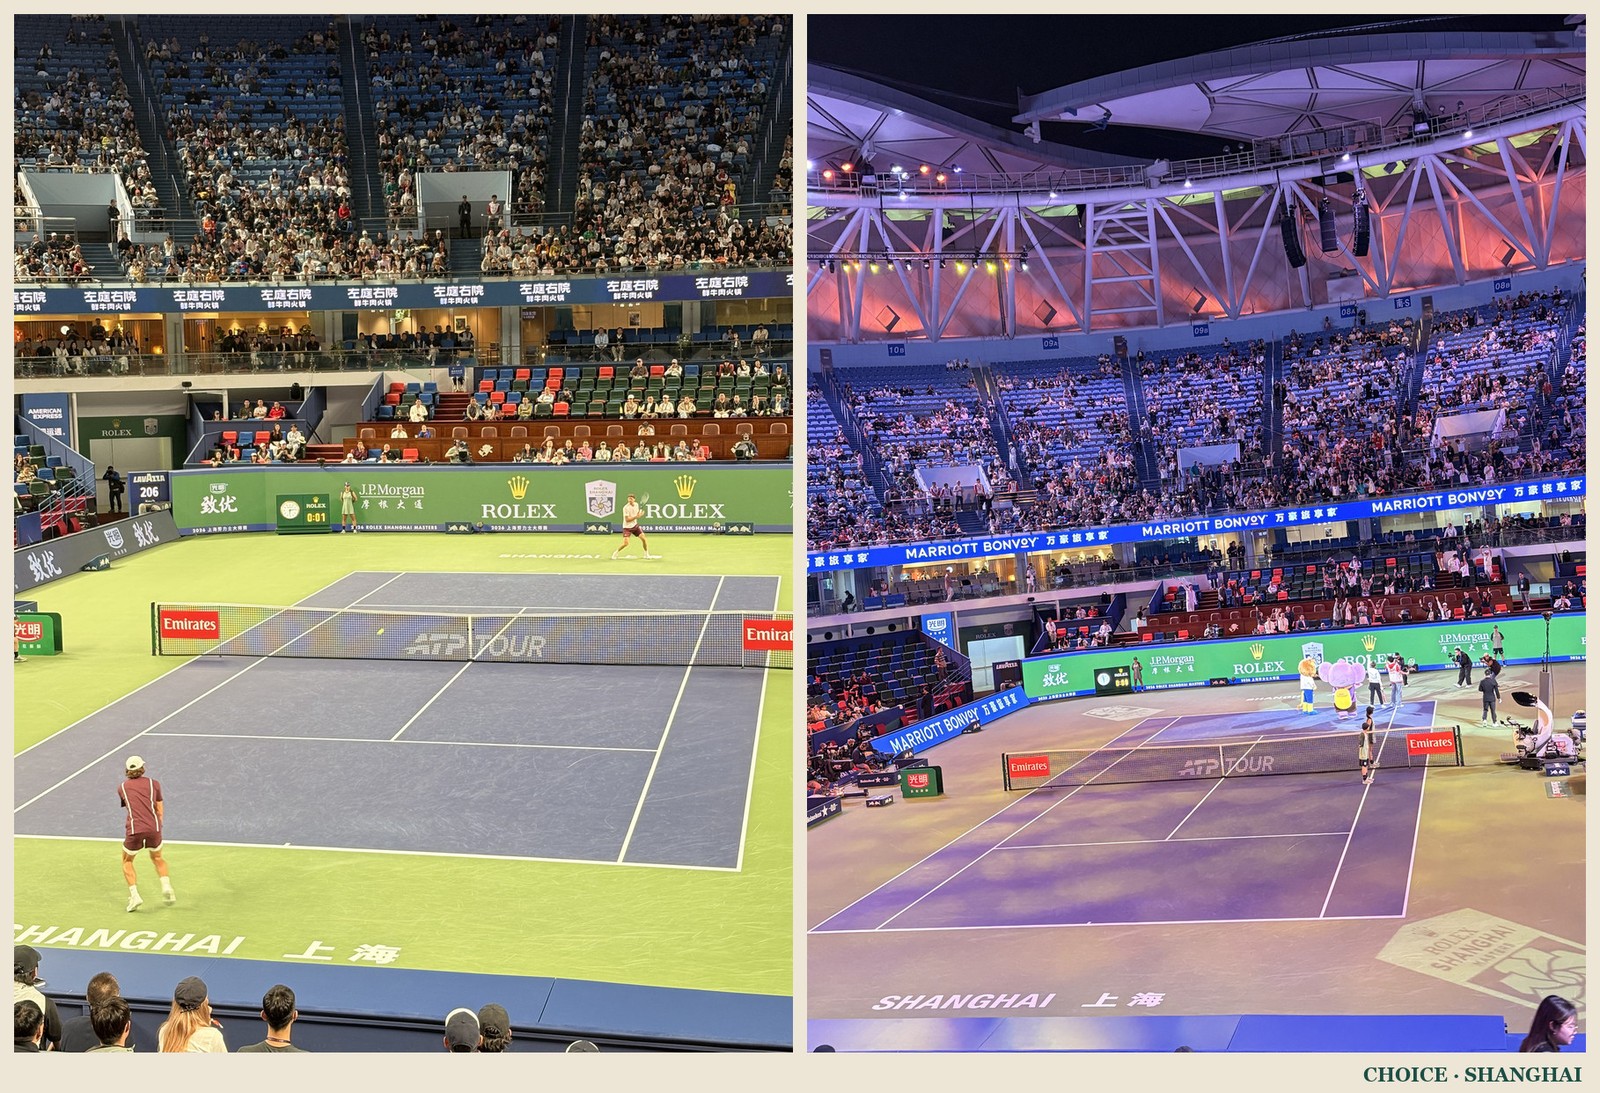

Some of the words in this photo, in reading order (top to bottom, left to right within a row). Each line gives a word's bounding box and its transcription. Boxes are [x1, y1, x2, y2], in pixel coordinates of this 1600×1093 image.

[520, 282, 571, 296] 左庭右院
[607, 280, 658, 292] 左庭右院
[695, 276, 748, 289] 左庭右院
[84, 290, 137, 303] 左庭右院
[173, 290, 225, 302] 左庭右院
[260, 289, 312, 300] 左庭右院
[348, 288, 398, 299] 左庭右院
[433, 285, 484, 298] 左庭右院
[1043, 339, 1059, 348] 09A
[102, 429, 132, 437] ROLEX
[133, 474, 166, 483] LAVAZZA
[140, 486, 159, 498] 206
[359, 484, 424, 498] J.P.Morgan
[1372, 496, 1443, 513] MARRIOTT
[1448, 488, 1506, 506] BONVOY
[1514, 480, 1582, 497] 万豪旅享家
[200, 494, 238, 514] 致优
[361, 499, 424, 510] 摩根大通
[481, 504, 558, 518] ROLEX
[646, 504, 726, 518] ROLEX
[306, 512, 326, 522] 0:01
[1142, 520, 1210, 537] MARRIOTT
[1215, 514, 1268, 530] BONVOY
[1276, 507, 1338, 522] 万豪旅享家
[132, 520, 160, 548] 致优
[906, 542, 978, 560] MARRIOTT
[984, 537, 1038, 552] BONVOY
[1046, 530, 1109, 546] 万豪旅享家
[27, 550, 62, 582] 致优
[807, 552, 869, 568] 豪旅享家
[14, 624, 40, 636] 光明
[164, 618, 216, 630] Emirates
[1438, 632, 1490, 644] J.P.Morgan
[404, 634, 466, 656] ATP
[475, 634, 546, 658] TOUR
[1150, 656, 1194, 666] J.P.Morgan
[1233, 661, 1286, 675] ROLEX
[1042, 672, 1068, 687] 致优
[890, 722, 944, 754] MARRIOTT
[942, 708, 978, 732] BONVOY
[1410, 737, 1452, 749] Emirates
[1011, 760, 1048, 772] Emirates
[1178, 758, 1219, 776] ATP
[1225, 755, 1274, 772] TOUR
[910, 774, 928, 784] 光明
[1424, 926, 1478, 956] ROLEX
[284, 940, 402, 964] 上海
[1430, 925, 1516, 972] SHANGHAI
[1473, 942, 1516, 967] MASTERS
[872, 994, 1056, 1010] SHANGHAI
[1081, 992, 1166, 1008] 上海
